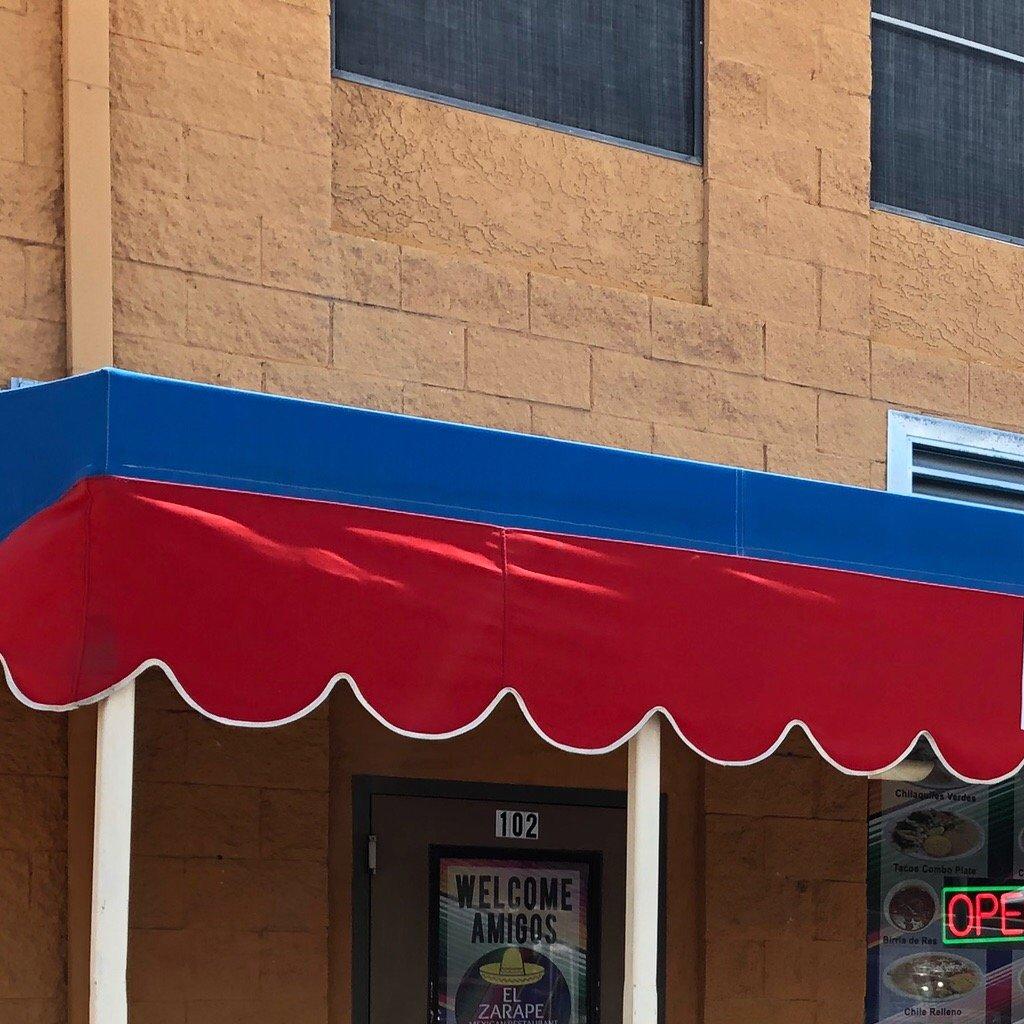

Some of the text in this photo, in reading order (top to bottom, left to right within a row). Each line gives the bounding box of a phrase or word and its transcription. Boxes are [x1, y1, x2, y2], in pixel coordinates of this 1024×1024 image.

[895, 789, 977, 802] Chilaquiles Verdes
[500, 811, 538, 838] 102
[893, 863, 977, 875] Tacos Combo Plate
[455, 874, 573, 912] WELCOME
[471, 912, 557, 945] AMIGOS
[882, 935, 938, 946] Birria de Res
[503, 987, 521, 1003] EL
[478, 1004, 545, 1020] ZARAPE
[904, 1008, 962, 1017] Chile Relleno
